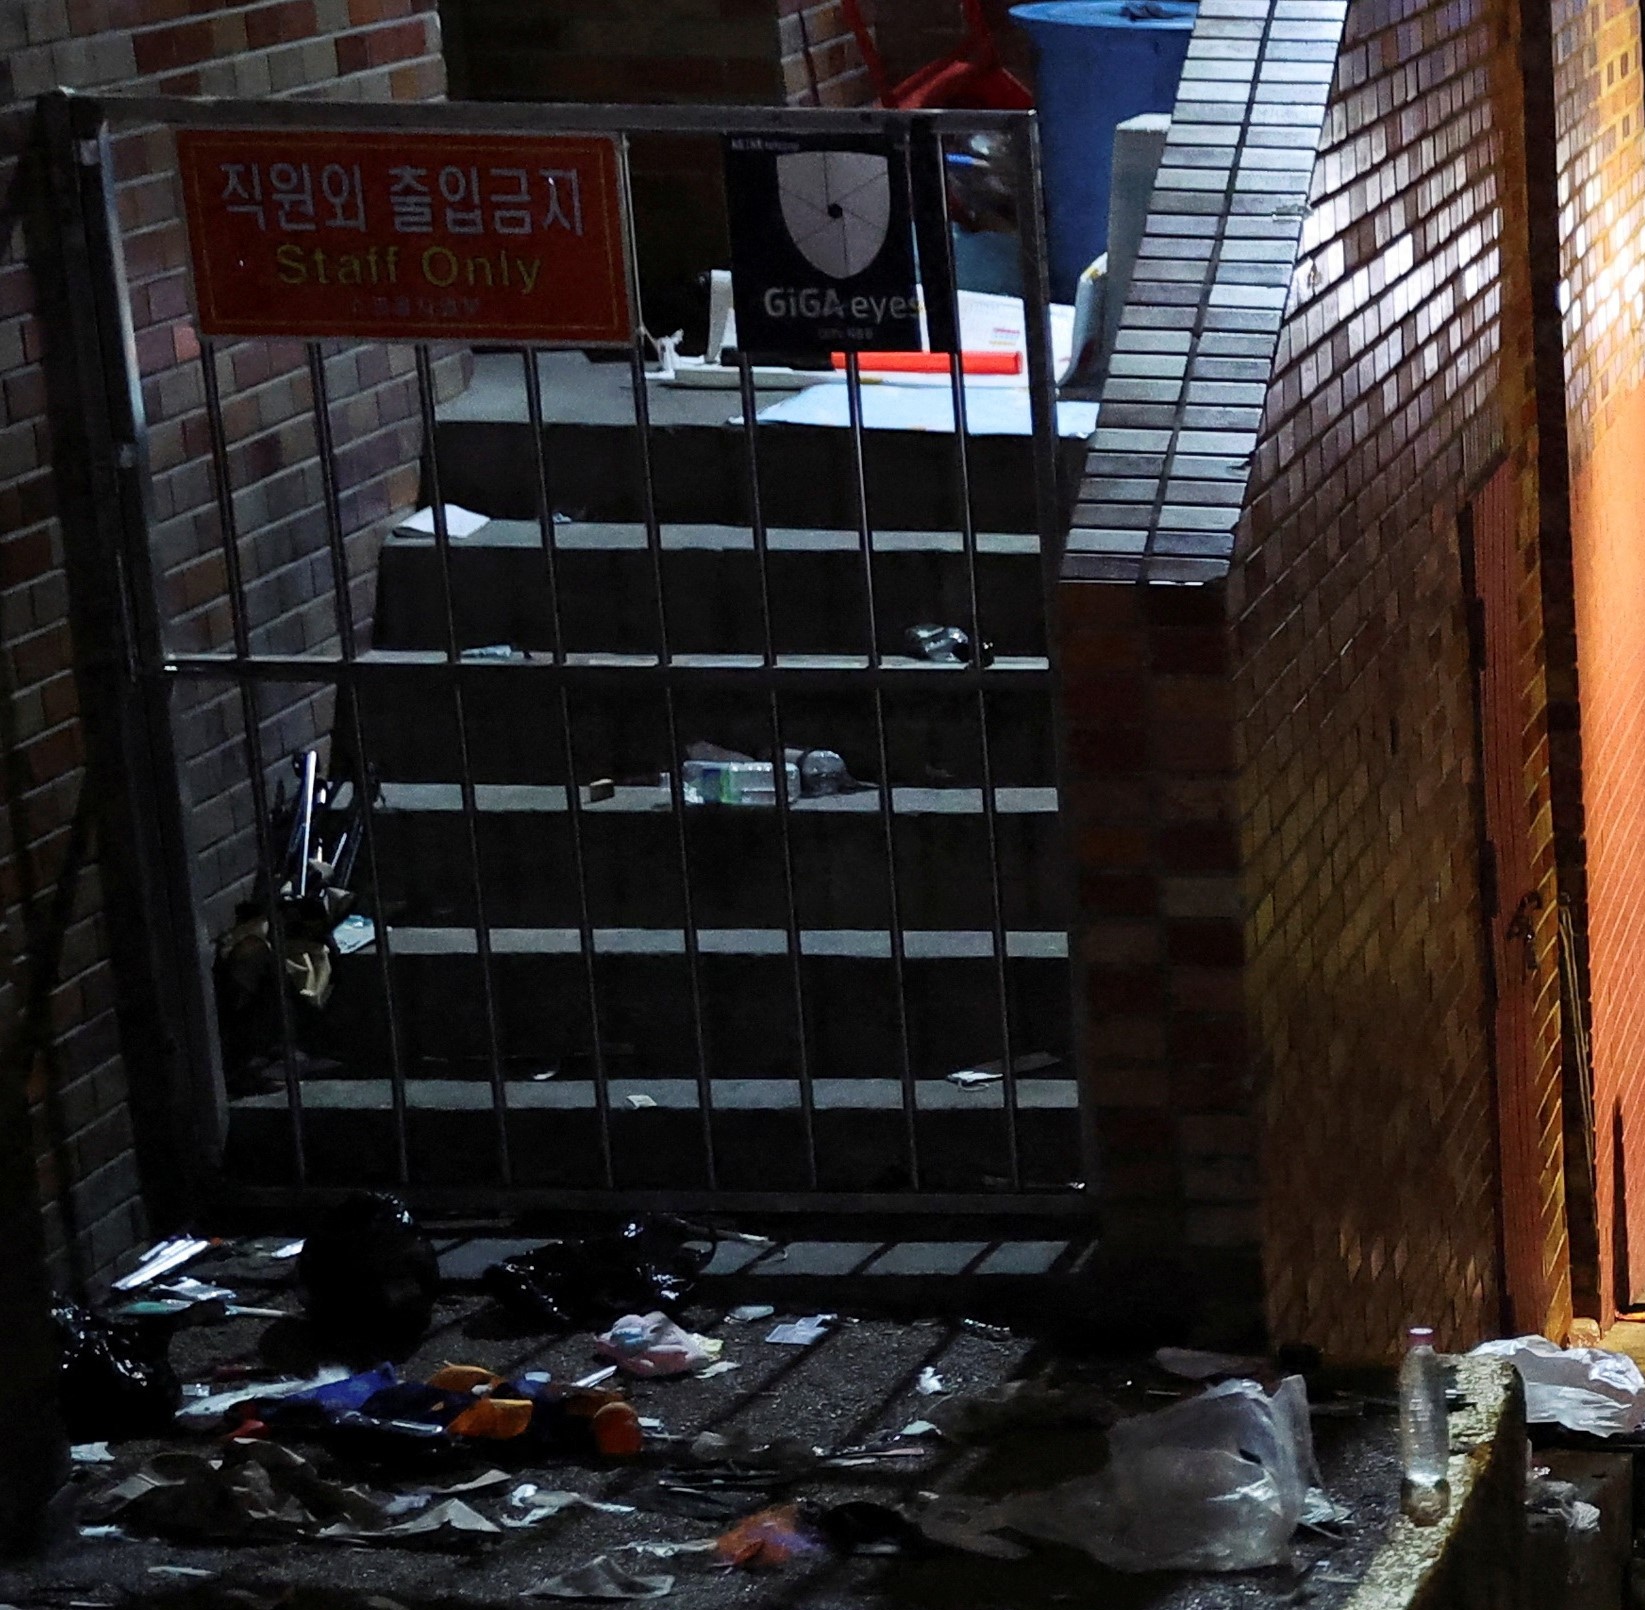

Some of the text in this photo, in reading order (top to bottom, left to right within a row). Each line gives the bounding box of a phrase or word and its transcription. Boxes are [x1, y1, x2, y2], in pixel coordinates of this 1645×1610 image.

[218, 161, 584, 237] 직원외 출입금지
[276, 244, 541, 295] Staff Only
[763, 286, 846, 318] GiGA
